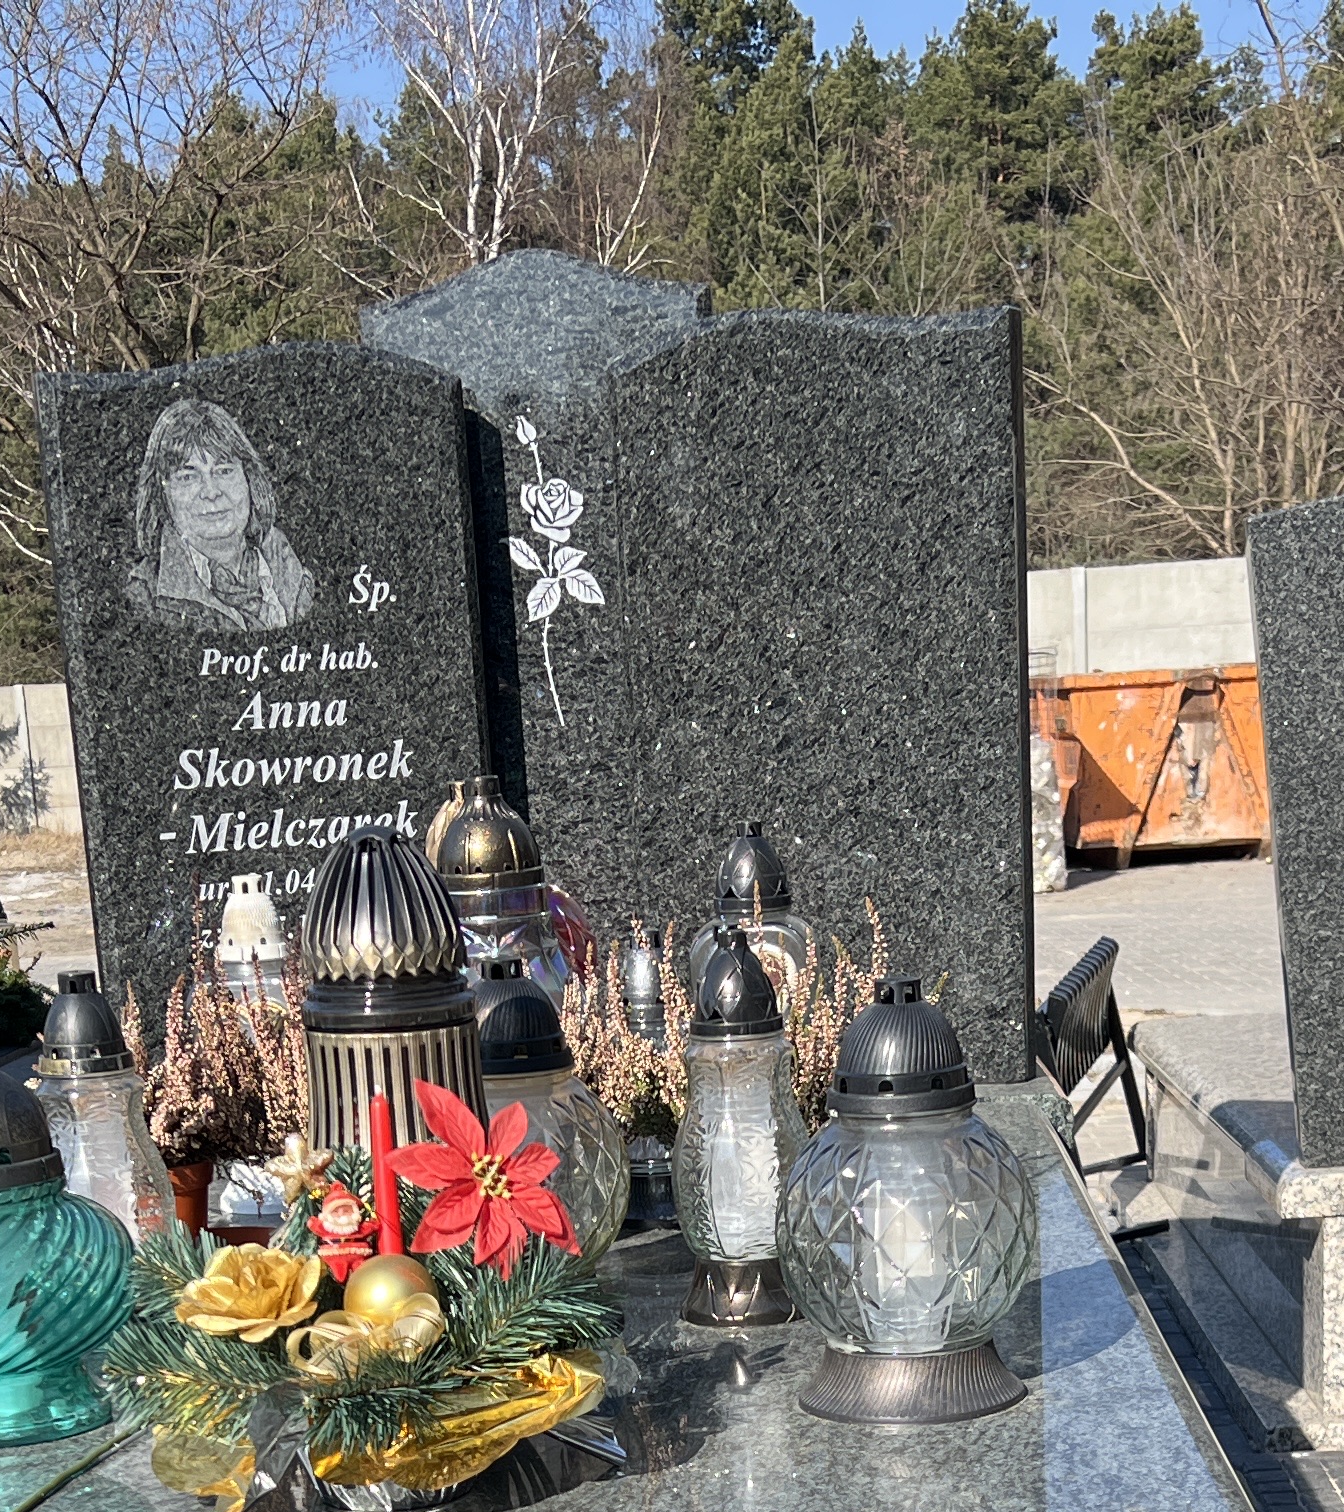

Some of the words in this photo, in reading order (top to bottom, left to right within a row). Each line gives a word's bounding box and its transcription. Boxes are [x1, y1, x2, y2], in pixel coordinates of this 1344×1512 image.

[348, 564, 397, 612] Śp.
[198, 645, 270, 682] Prof.
[280, 644, 312, 673] dr
[319, 641, 379, 671] hab.
[231, 690, 348, 731] Anna
[173, 738, 414, 791] Skowronek
